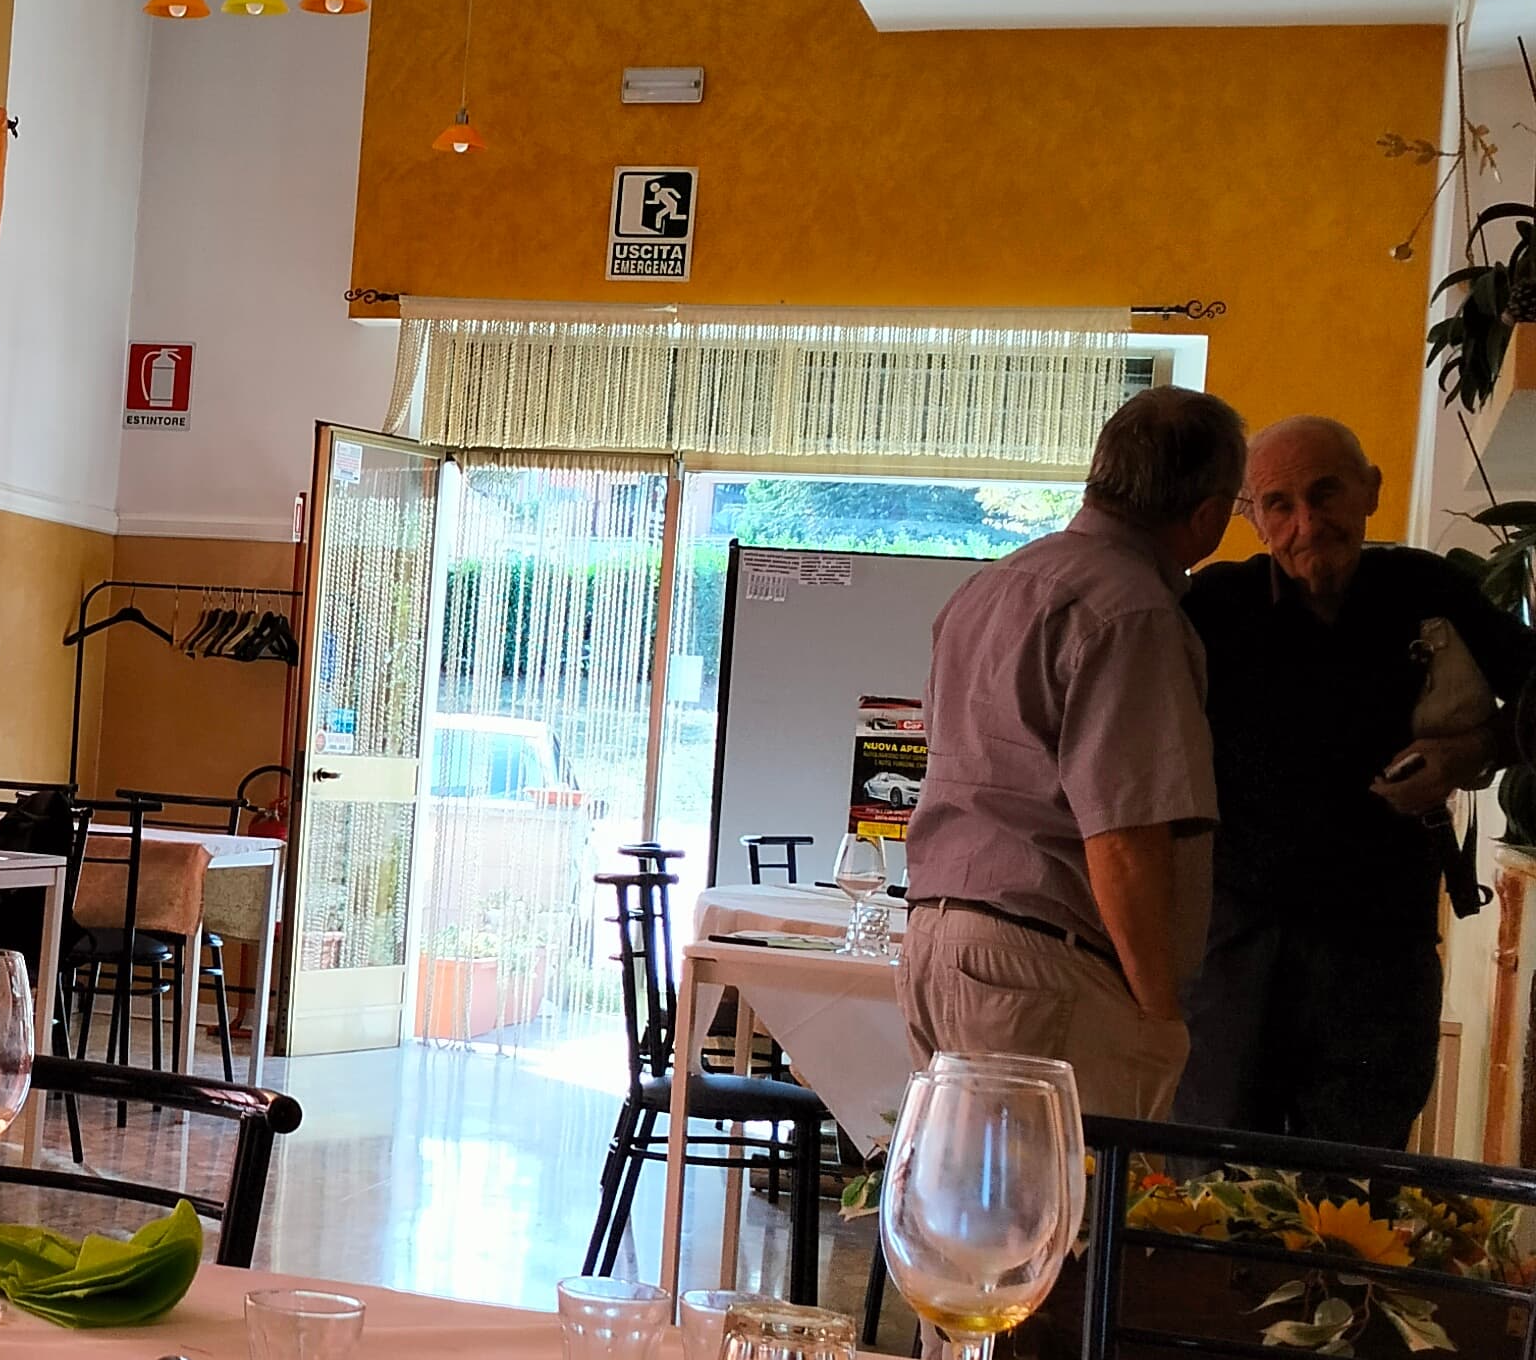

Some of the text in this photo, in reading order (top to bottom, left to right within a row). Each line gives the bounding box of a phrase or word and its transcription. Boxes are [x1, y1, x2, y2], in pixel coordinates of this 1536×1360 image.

[615, 244, 683, 259] USCITA
[613, 259, 682, 275] EMERGENZA
[126, 415, 186, 426] ESTINTORE
[863, 741, 898, 752] NUOVA
